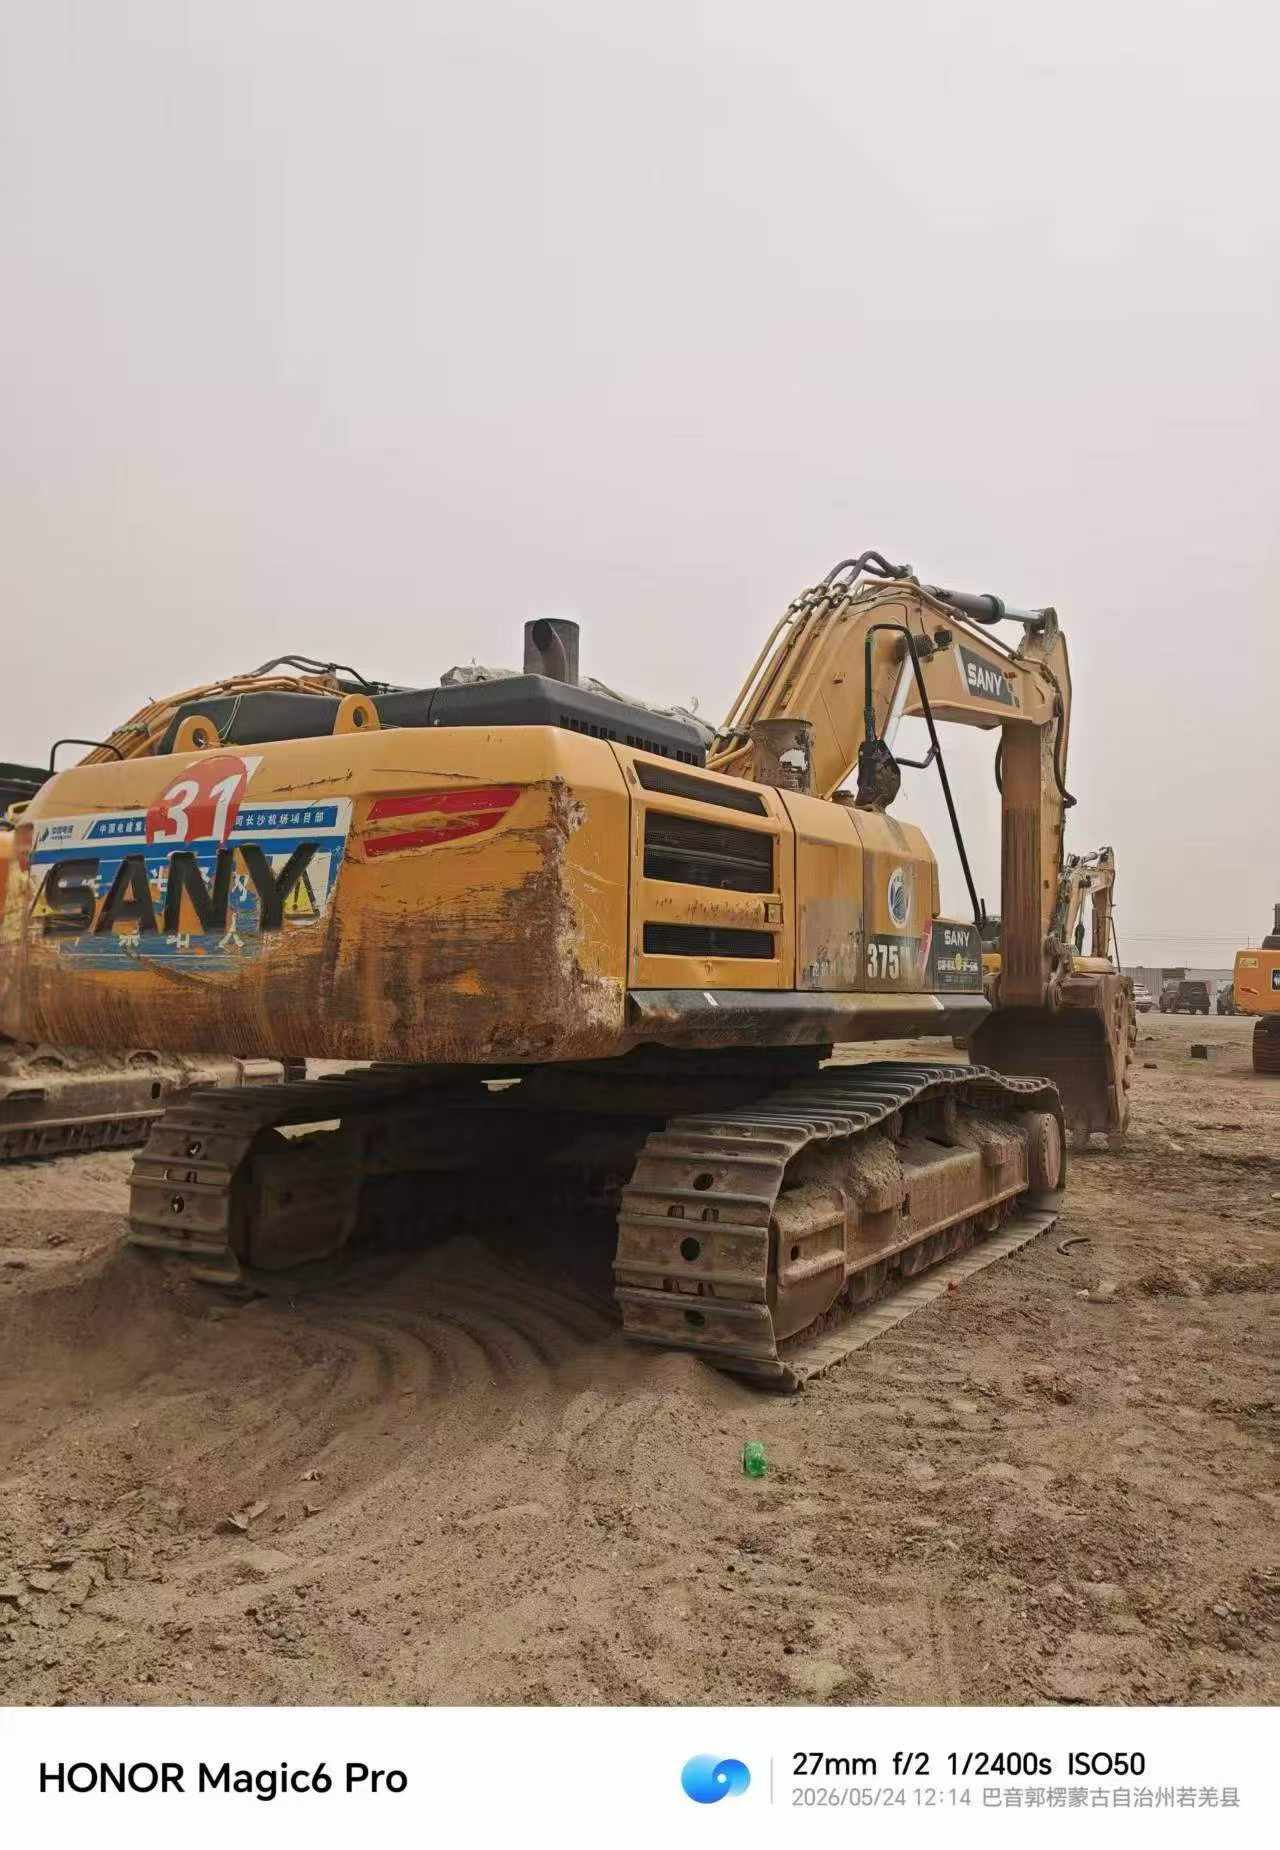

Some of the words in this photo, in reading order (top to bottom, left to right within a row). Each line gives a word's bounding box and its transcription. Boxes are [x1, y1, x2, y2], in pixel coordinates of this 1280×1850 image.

[967, 662, 1003, 697] SANY
[153, 774, 246, 844] 31
[43, 842, 321, 937] SANY
[944, 929, 971, 948] SANY
